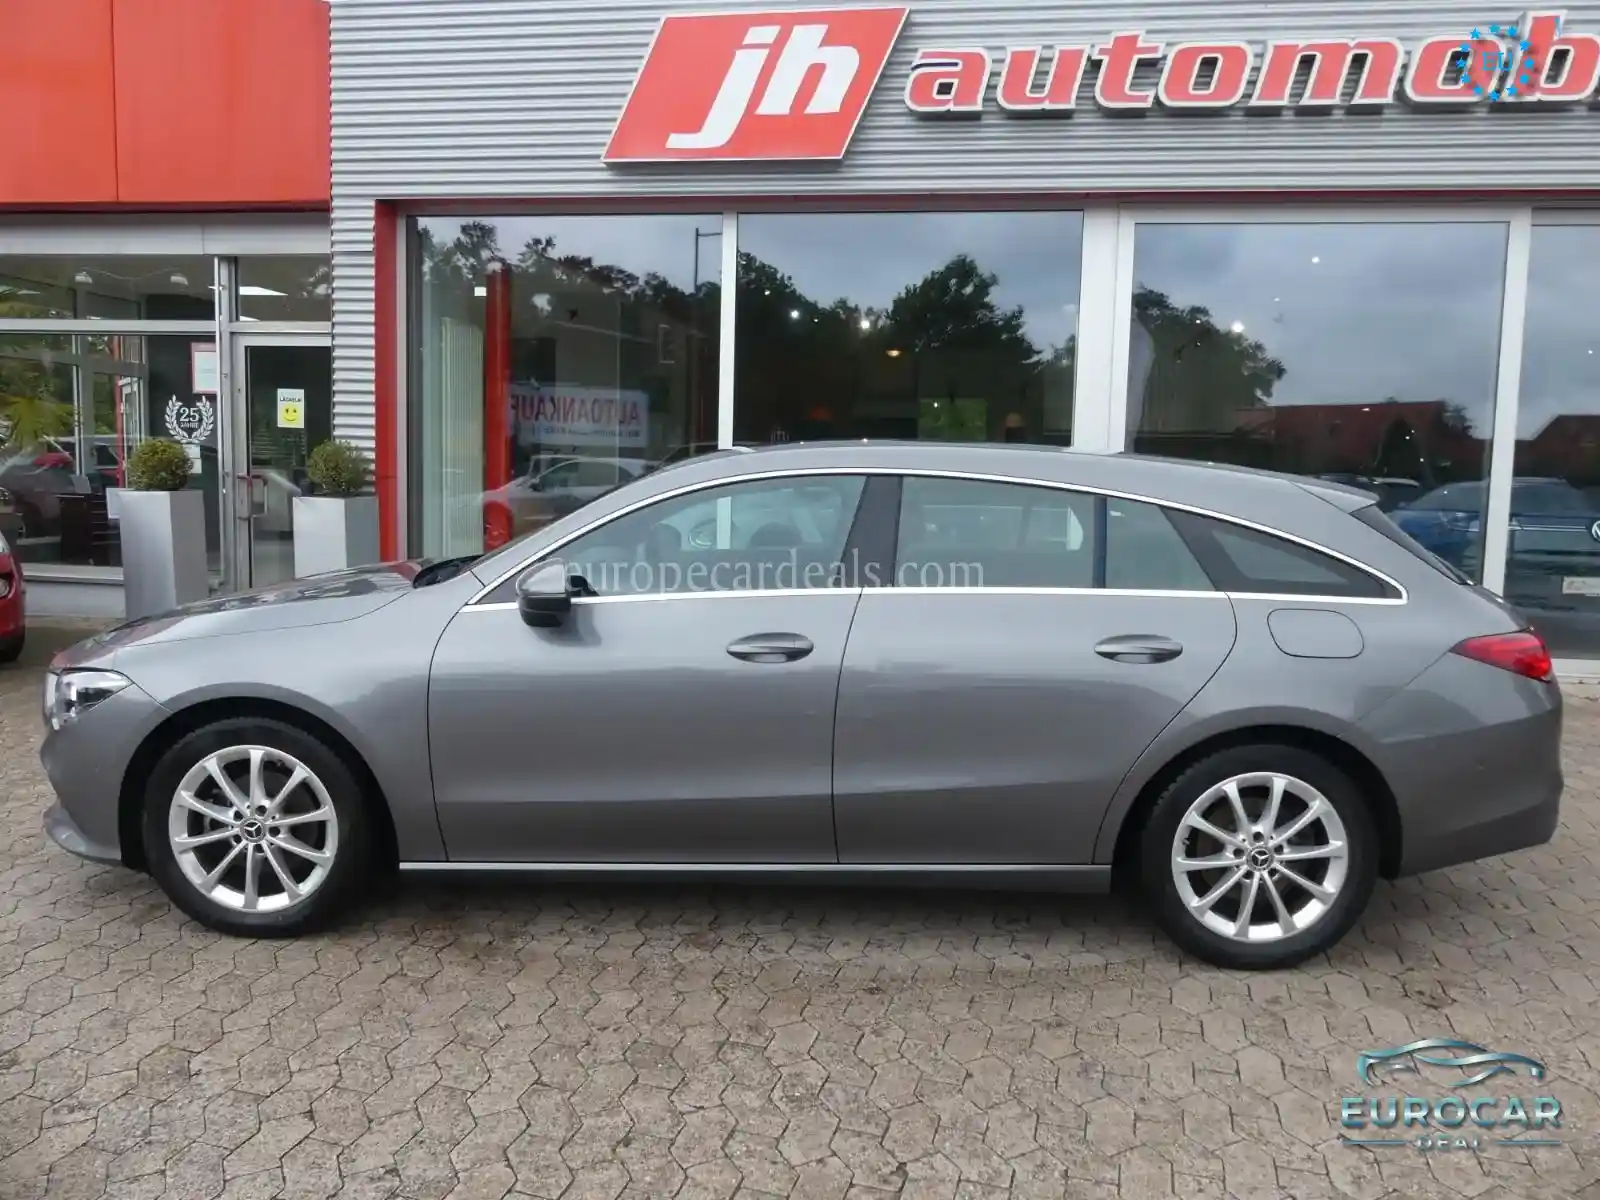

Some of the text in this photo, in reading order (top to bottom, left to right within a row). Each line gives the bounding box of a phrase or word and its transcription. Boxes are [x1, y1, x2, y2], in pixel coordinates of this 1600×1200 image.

[666, 26, 862, 149] jh
[905, 10, 1600, 112] automob
[179, 407, 200, 422] 25
